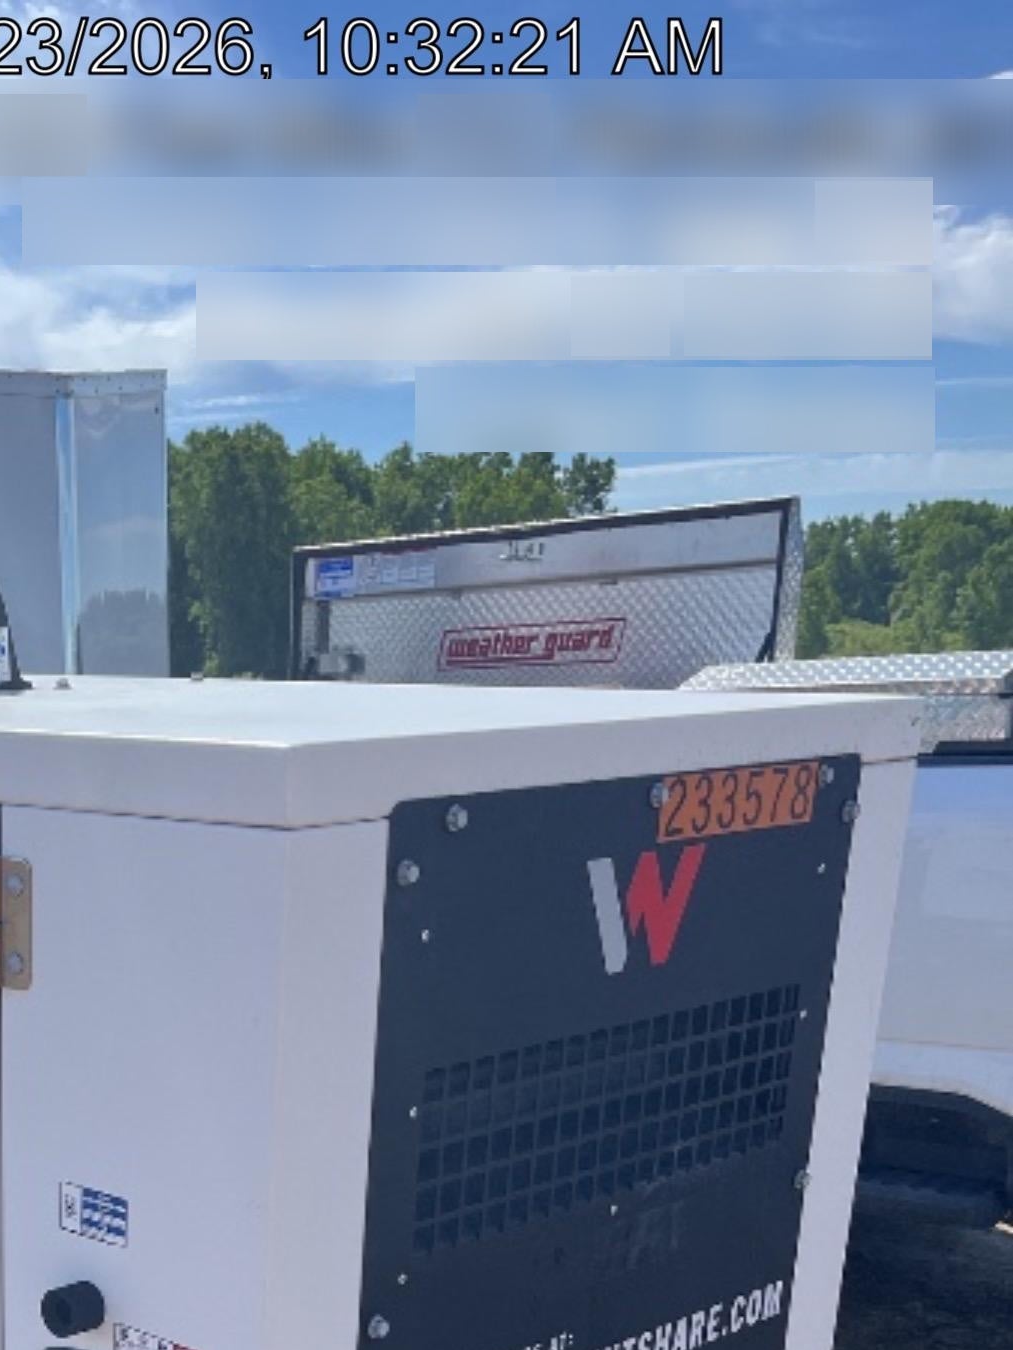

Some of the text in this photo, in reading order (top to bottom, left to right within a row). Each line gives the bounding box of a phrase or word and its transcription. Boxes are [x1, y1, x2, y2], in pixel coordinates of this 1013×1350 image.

[448, 624, 616, 660] weather guard
[663, 764, 815, 838] 233578
